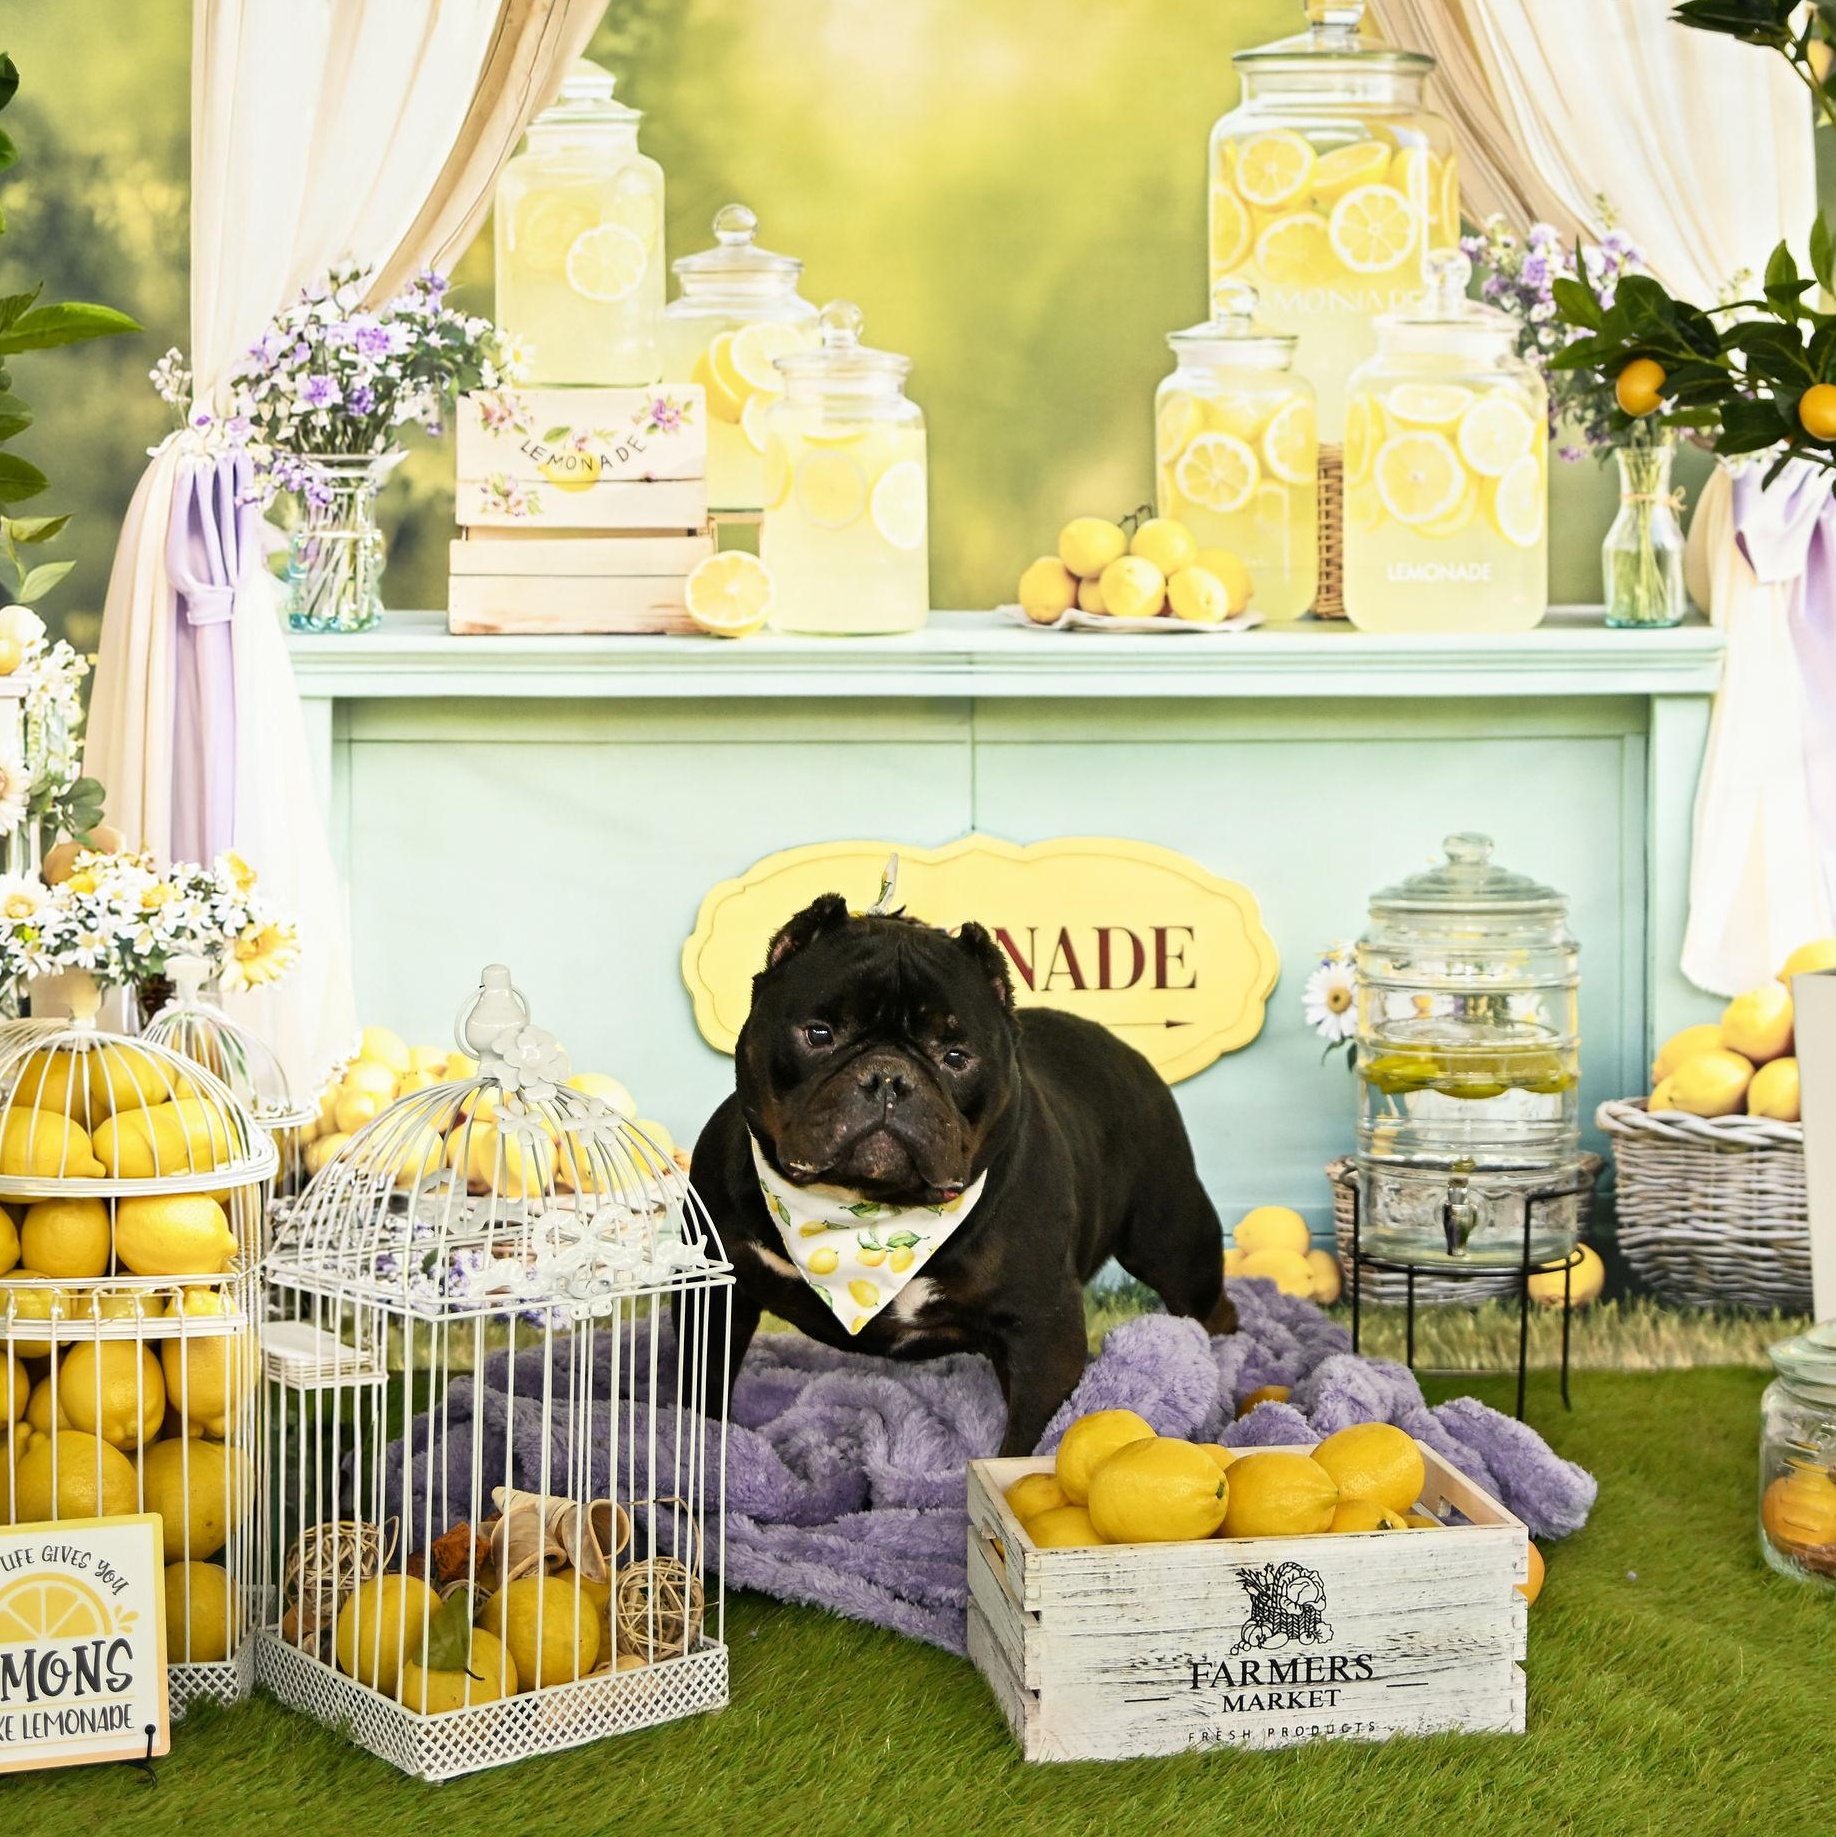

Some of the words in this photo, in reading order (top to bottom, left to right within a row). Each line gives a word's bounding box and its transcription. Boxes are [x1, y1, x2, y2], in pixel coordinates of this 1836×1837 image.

[520, 434, 647, 472] LEMONADE
[1386, 562, 1493, 582] LEMONADE
[949, 926, 1198, 992] NADE
[0, 1547, 35, 1572] LIFE
[42, 1544, 92, 1569] GIVES
[94, 1559, 130, 1596] YOU
[0, 1637, 134, 1702] MONS
[1189, 1653, 1374, 1690] FARMERS
[1221, 1689, 1341, 1713] MARKET
[22, 1703, 135, 1740] LEMONADE
[1188, 1728, 1251, 1743] FRESH
[1267, 1720, 1376, 1738] PRODUCTS
